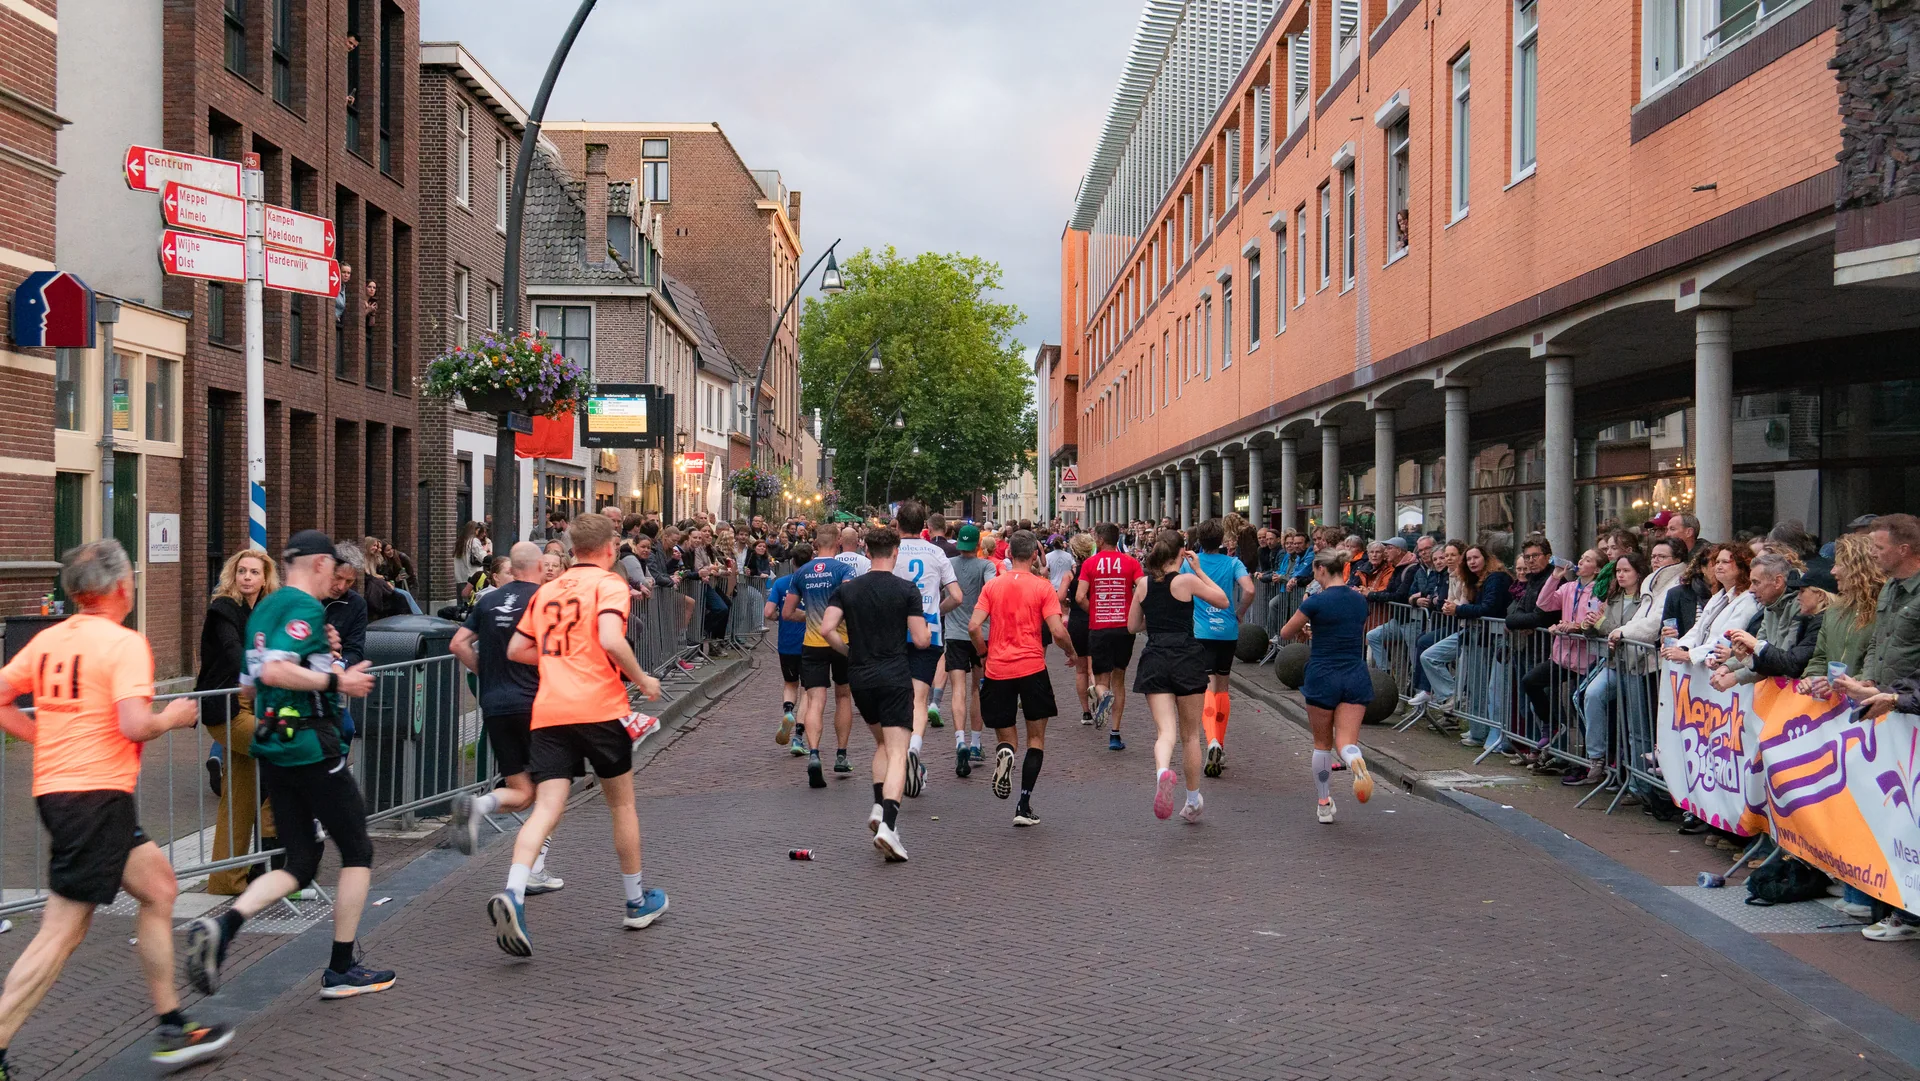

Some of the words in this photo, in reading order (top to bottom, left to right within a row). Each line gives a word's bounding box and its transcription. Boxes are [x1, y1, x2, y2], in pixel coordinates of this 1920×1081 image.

[147, 154, 193, 172] Centrum
[179, 190, 208, 206] Meppel
[179, 209, 207, 224] Almelo
[267, 210, 295, 227] Kampen
[267, 227, 303, 246] Apeldoorn
[178, 238, 201, 254] Wijhe
[178, 256, 195, 269] Olst
[268, 253, 309, 272] Harderwijk
[908, 558, 925, 589] 2
[1096, 557, 1122, 575] 414
[804, 571, 833, 579] SALVERDA
